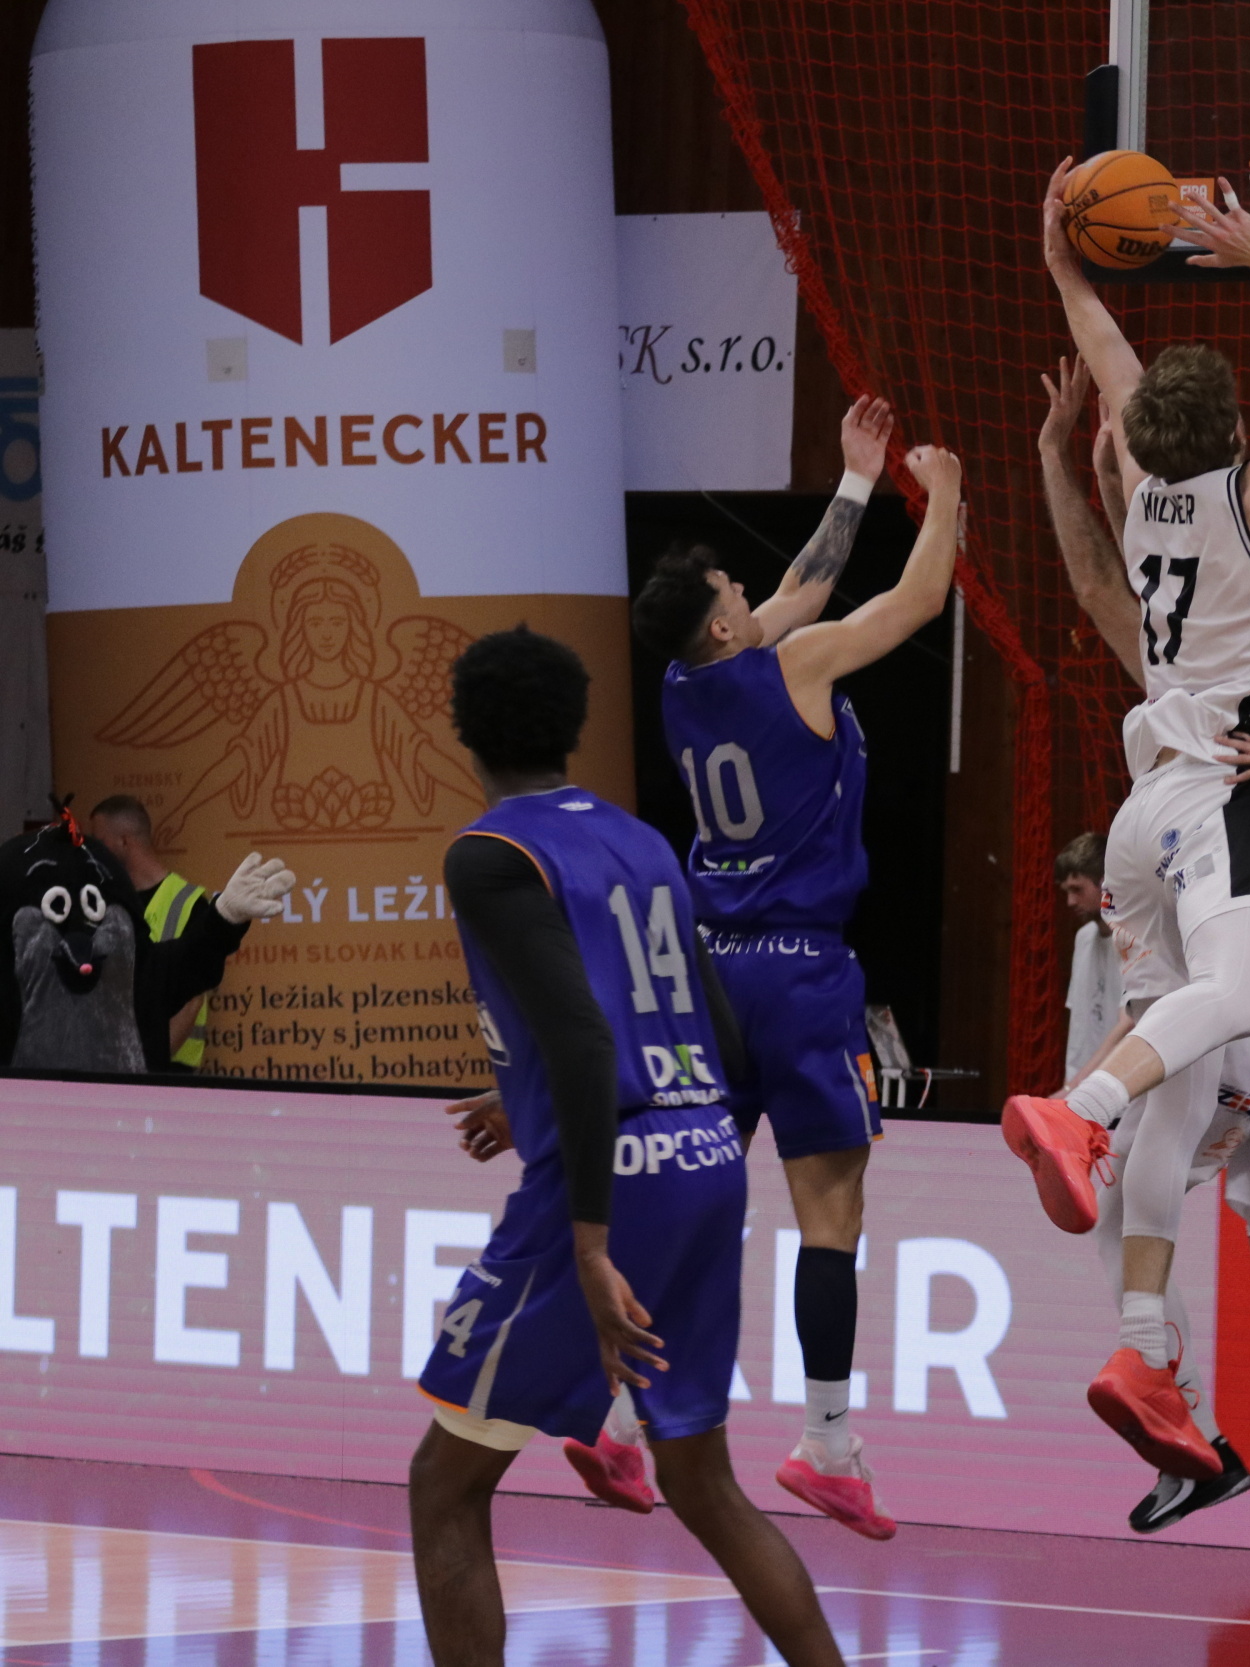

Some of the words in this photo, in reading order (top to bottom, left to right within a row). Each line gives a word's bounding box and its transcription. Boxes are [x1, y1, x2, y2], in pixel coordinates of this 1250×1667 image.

[681, 335, 784, 373] s.r.o.
[101, 412, 548, 479] KALTENECKER
[1139, 554, 1200, 665] 17
[682, 742, 765, 842] 10
[348, 876, 458, 922] LEŽI
[306, 942, 406, 964] SLOVAK
[609, 885, 694, 1013] 14
[260, 983, 345, 1010] ležiak
[251, 1020, 325, 1051] farby
[332, 1028, 347, 1045] s
[350, 1020, 458, 1050] jemnou
[371, 1052, 495, 1083] bohatým
